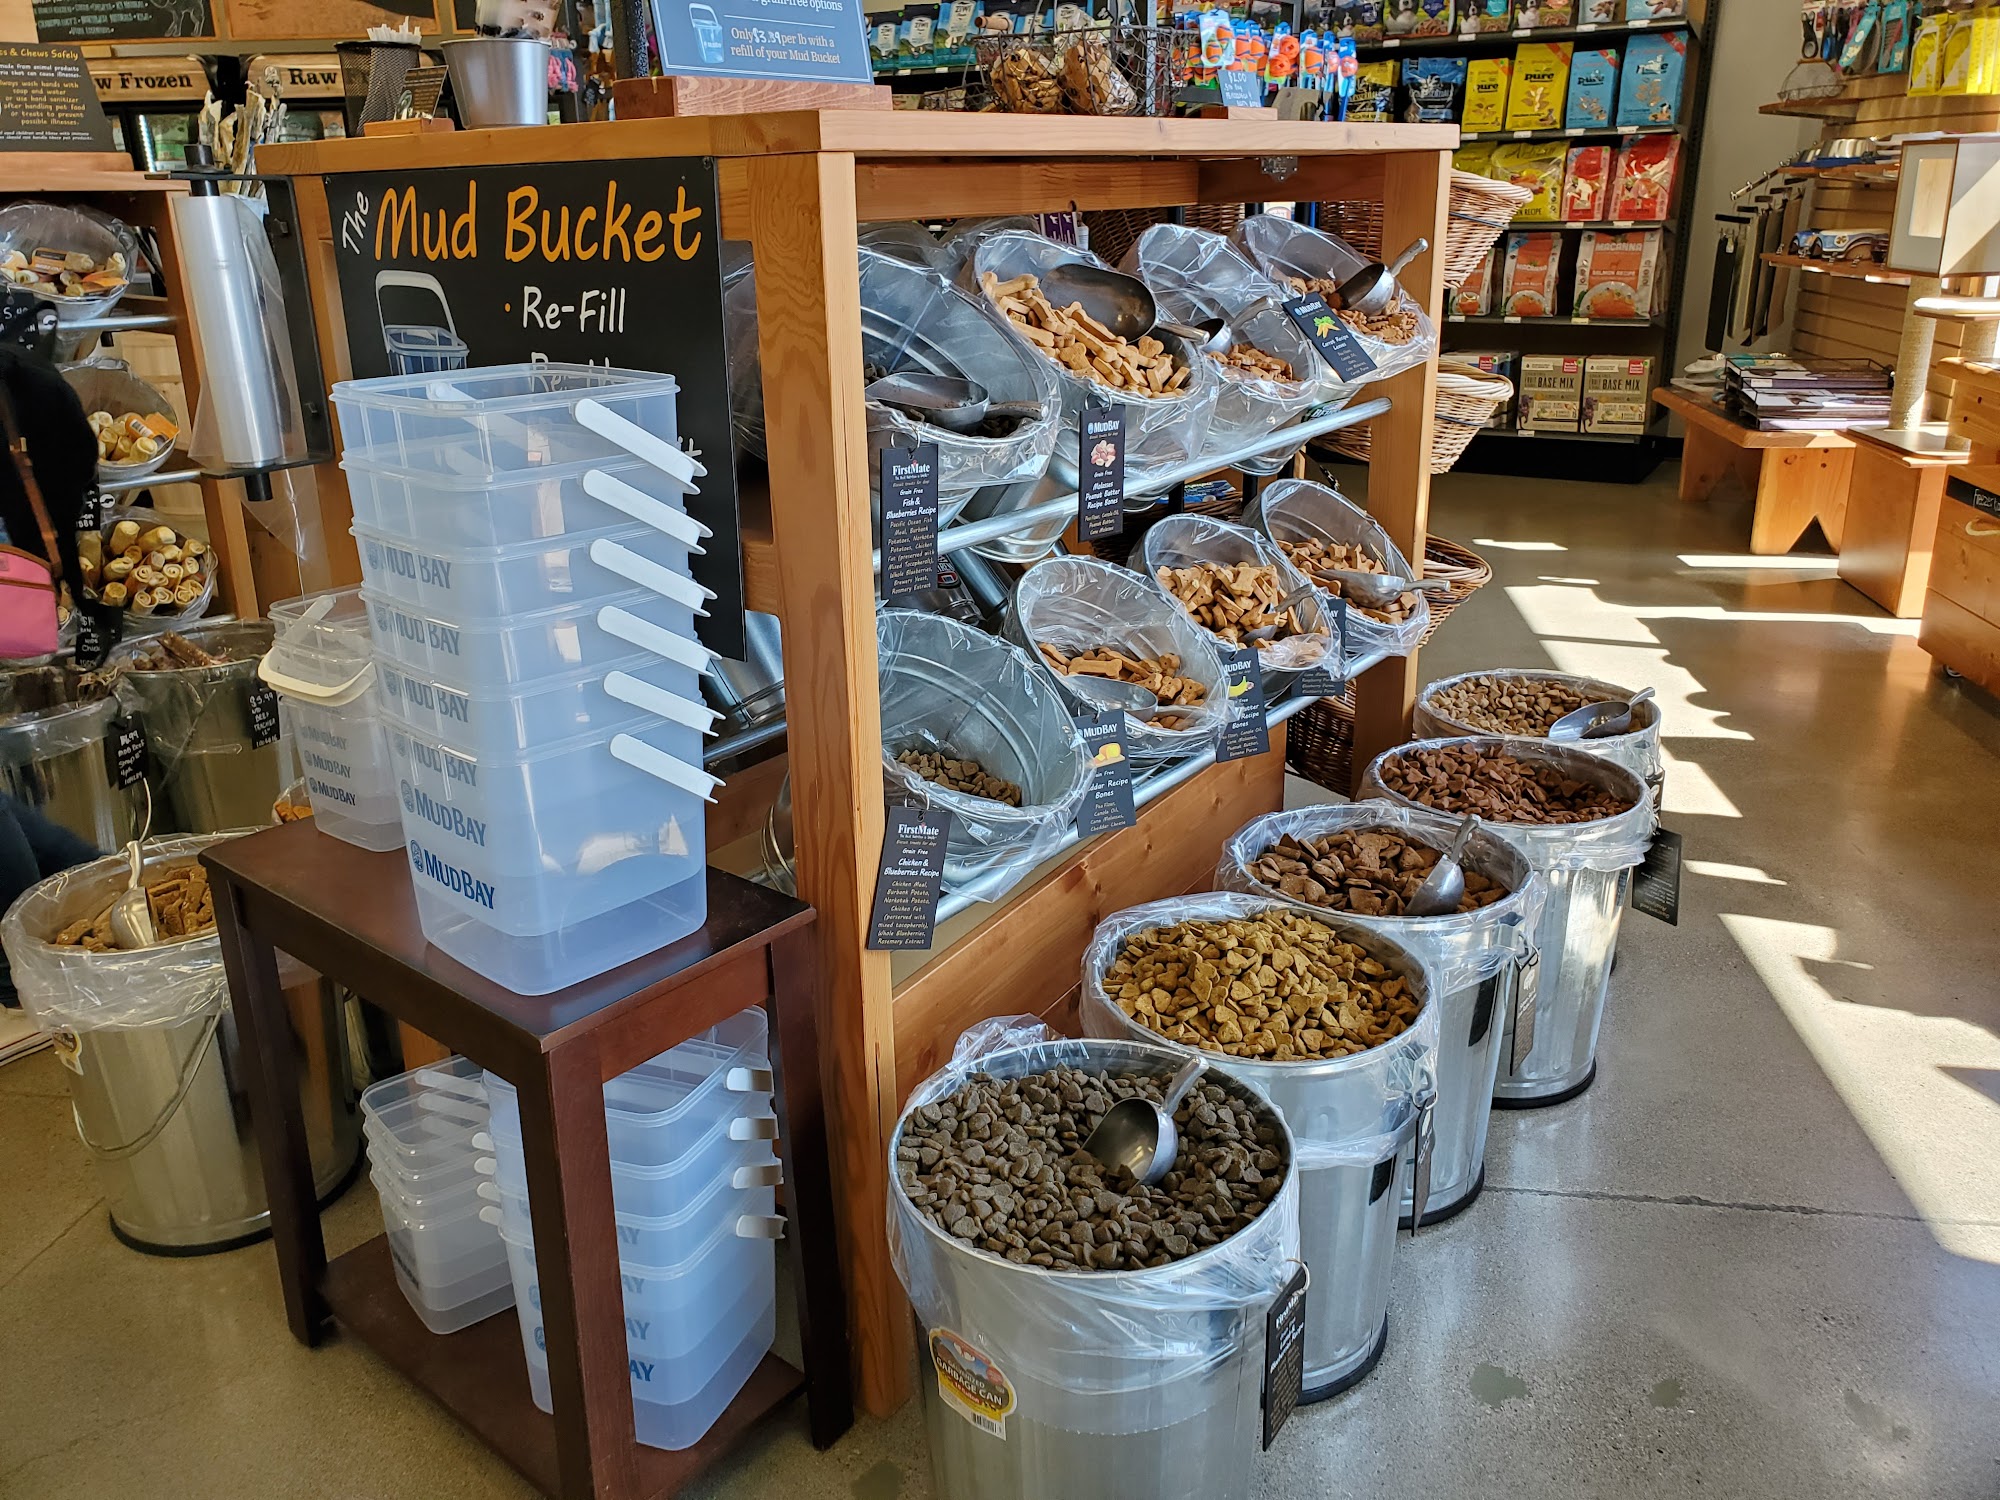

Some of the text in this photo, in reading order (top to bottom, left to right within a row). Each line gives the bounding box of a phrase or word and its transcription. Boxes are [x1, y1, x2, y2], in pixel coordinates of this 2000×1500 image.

[809, 0, 844, 12] options
[731, 27, 753, 43] Only
[781, 34, 796, 47] per
[798, 33, 807, 44] lb
[808, 36, 828, 48] with
[829, 39, 835, 48] a
[10, 48, 18, 56] &
[20, 48, 48, 58] Chews
[51, 49, 79, 61] Safely
[730, 44, 841, 64] refill of your Mud Bucket
[118, 73, 193, 89] Frozen
[287, 68, 338, 86] Raw
[1524, 72, 1554, 82] pure
[1524, 208, 1542, 216] RECIPE
[340, 180, 702, 263] The Mud Bucket
[522, 285, 626, 334] Re-Fill
[1538, 376, 1574, 389] BASE MIX
[1602, 379, 1640, 390] BASE MIX
[1094, 420, 1120, 434] MUDBAY
[892, 463, 930, 476] FirstMate
[1092, 482, 1114, 490] Molasses
[1085, 488, 1120, 501] Peanut Butter
[902, 497, 920, 507] Fish &
[1087, 498, 1118, 510] Recipe Bones
[886, 506, 936, 520] Blueberries Recipe
[380, 544, 452, 590] MUDBAY
[388, 609, 460, 656] MUDBAY
[399, 674, 469, 723] MUDBAY
[1240, 712, 1260, 720] Recipe
[1084, 724, 1118, 738] MUDBAY
[1232, 720, 1249, 730] Bones
[312, 754, 352, 779] MUDBAY
[1108, 778, 1128, 788] Recipe
[318, 780, 356, 806] MUDBAY
[1095, 790, 1114, 800] Bones
[414, 788, 486, 848] MUDBAY
[898, 824, 940, 836] FirstMate
[1090, 820, 1126, 832] Cheddar Cheese
[898, 858, 929, 867] Chicken &
[884, 866, 940, 878] Blueberries Recipe
[424, 848, 496, 910] MUDBAY
[878, 938, 903, 946] Rosemary
[936, 1356, 977, 1394] GARBAGE
[978, 1389, 1002, 1406] CAN
